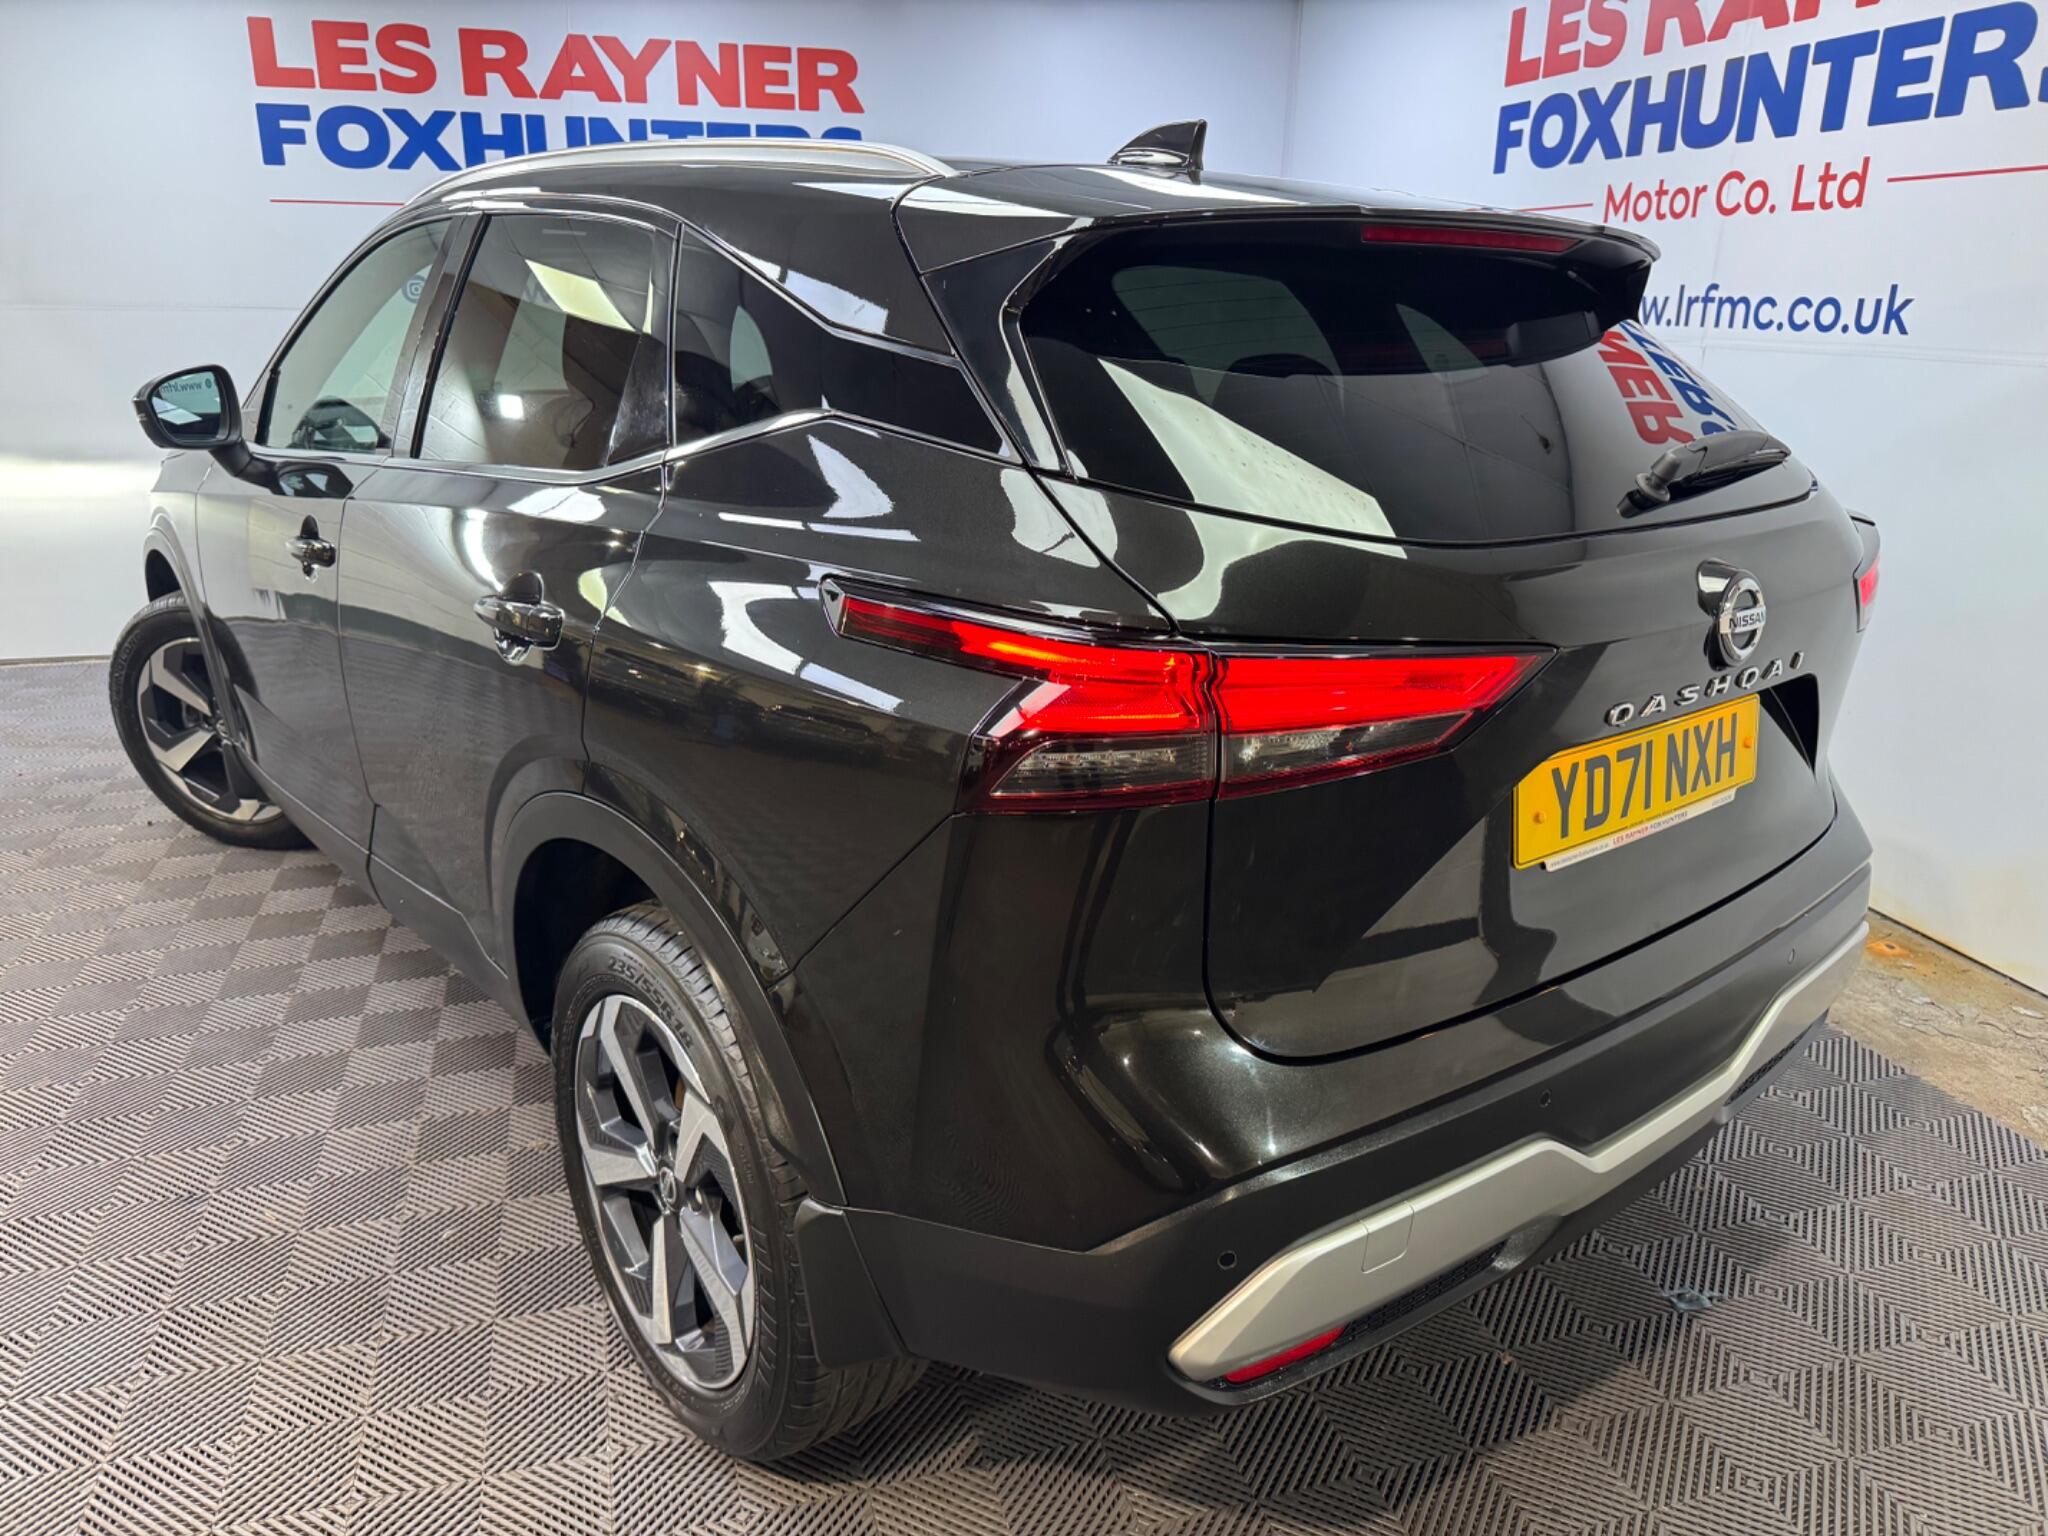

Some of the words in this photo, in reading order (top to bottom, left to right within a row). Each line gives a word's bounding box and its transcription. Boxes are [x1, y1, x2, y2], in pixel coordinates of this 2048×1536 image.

[247, 16, 437, 94] LES
[458, 27, 865, 114] RAYNER
[1504, 0, 1629, 88] LES
[1493, 1, 2048, 175] FOXHUNTER
[256, 102, 865, 171] FOXHU
[1603, 179, 1708, 224] Motor
[1715, 170, 1777, 217] Co.
[1790, 156, 1872, 212] Ltd
[1641, 283, 1916, 336] w.lrfmc.co.uk
[1728, 609, 1766, 629] NISSAN
[1605, 651, 1804, 728] QASHQAI
[1551, 739, 1654, 839] YD71
[1664, 713, 1738, 802] NXH
